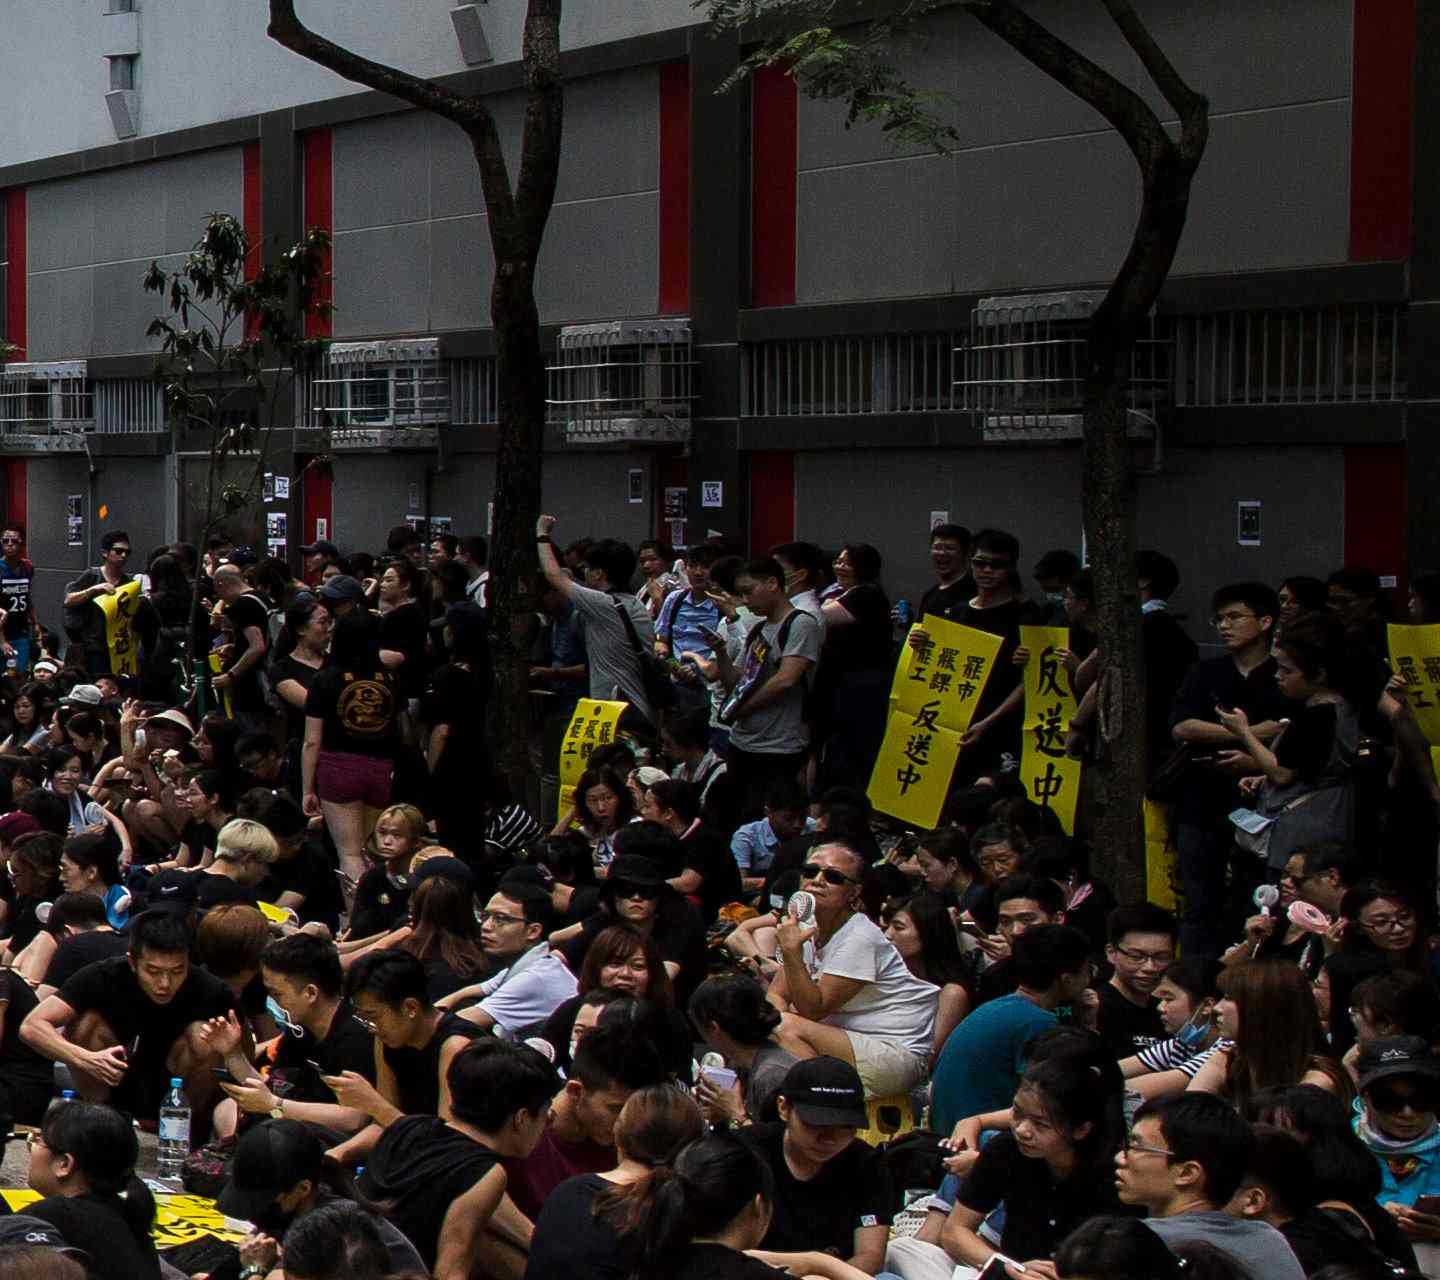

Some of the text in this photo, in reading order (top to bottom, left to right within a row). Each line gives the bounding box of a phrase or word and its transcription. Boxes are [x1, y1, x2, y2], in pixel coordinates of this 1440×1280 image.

[9, 595, 28, 613] 25
[929, 647, 960, 694] 罷課
[957, 655, 986, 702] 罷市
[896, 700, 942, 797] 反送中
[1033, 646, 1067, 811] 反送中
[25, 1232, 49, 1244] OR
